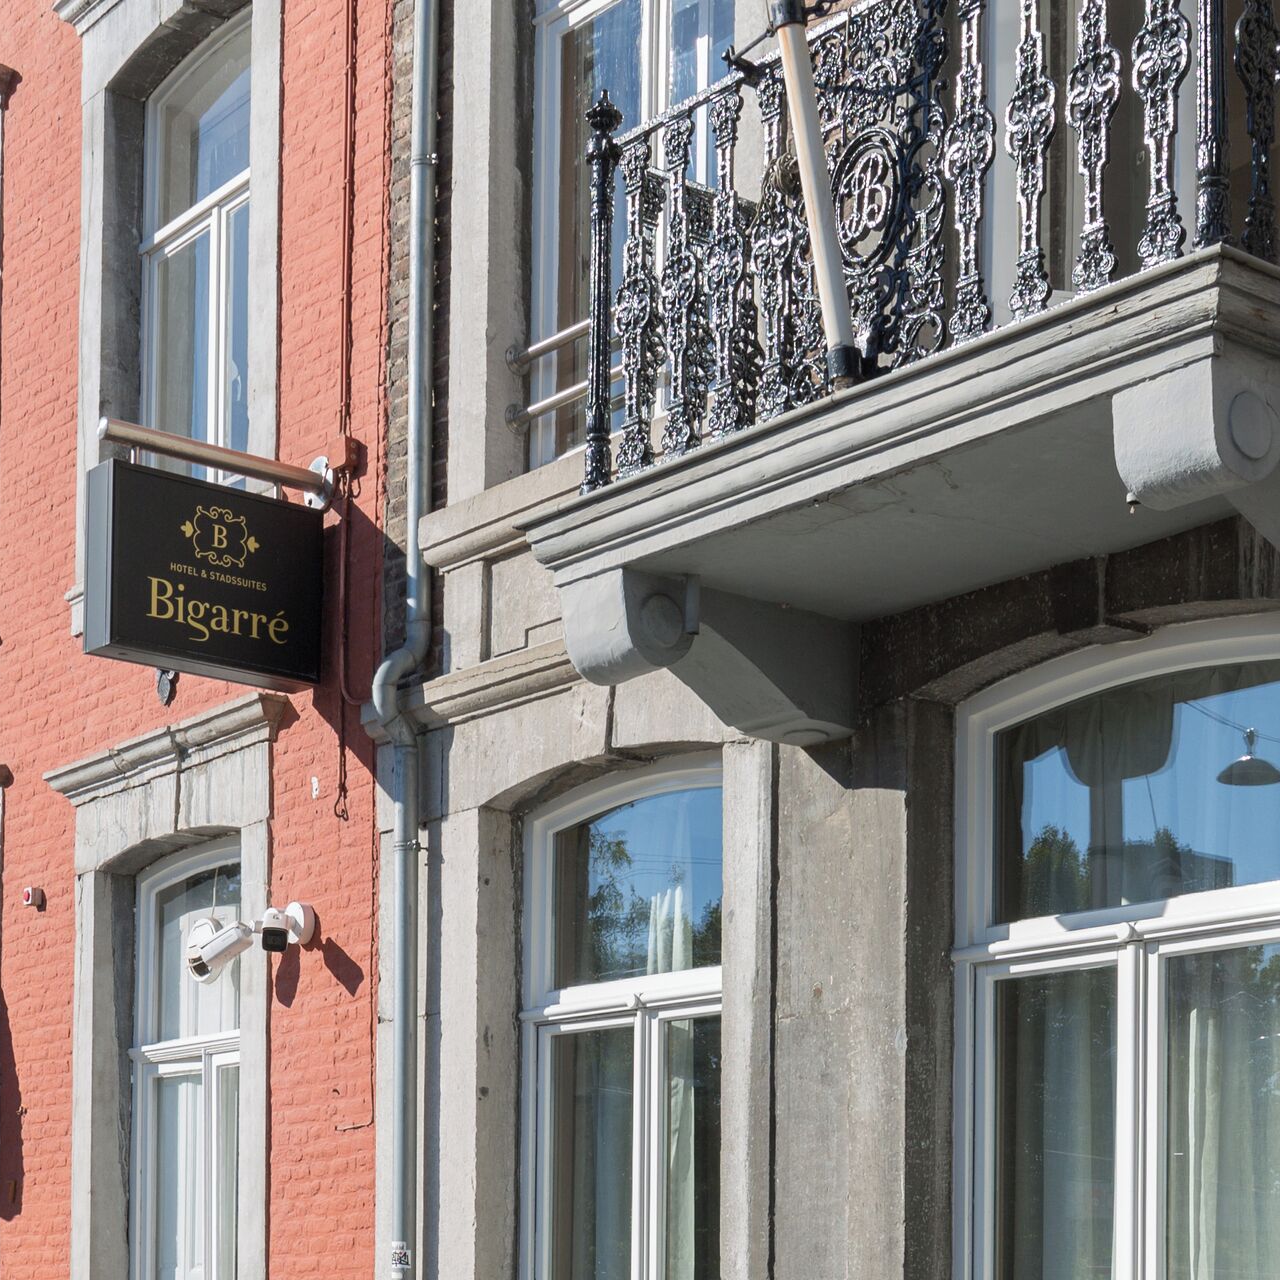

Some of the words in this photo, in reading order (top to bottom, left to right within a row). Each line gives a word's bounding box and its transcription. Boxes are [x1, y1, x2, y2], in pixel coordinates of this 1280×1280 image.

[212, 523, 228, 549] B
[170, 561, 199, 577] HOTEL
[200, 569, 208, 578] &
[209, 571, 268, 592] STADSSUITES
[146, 576, 289, 645] Bigarré
